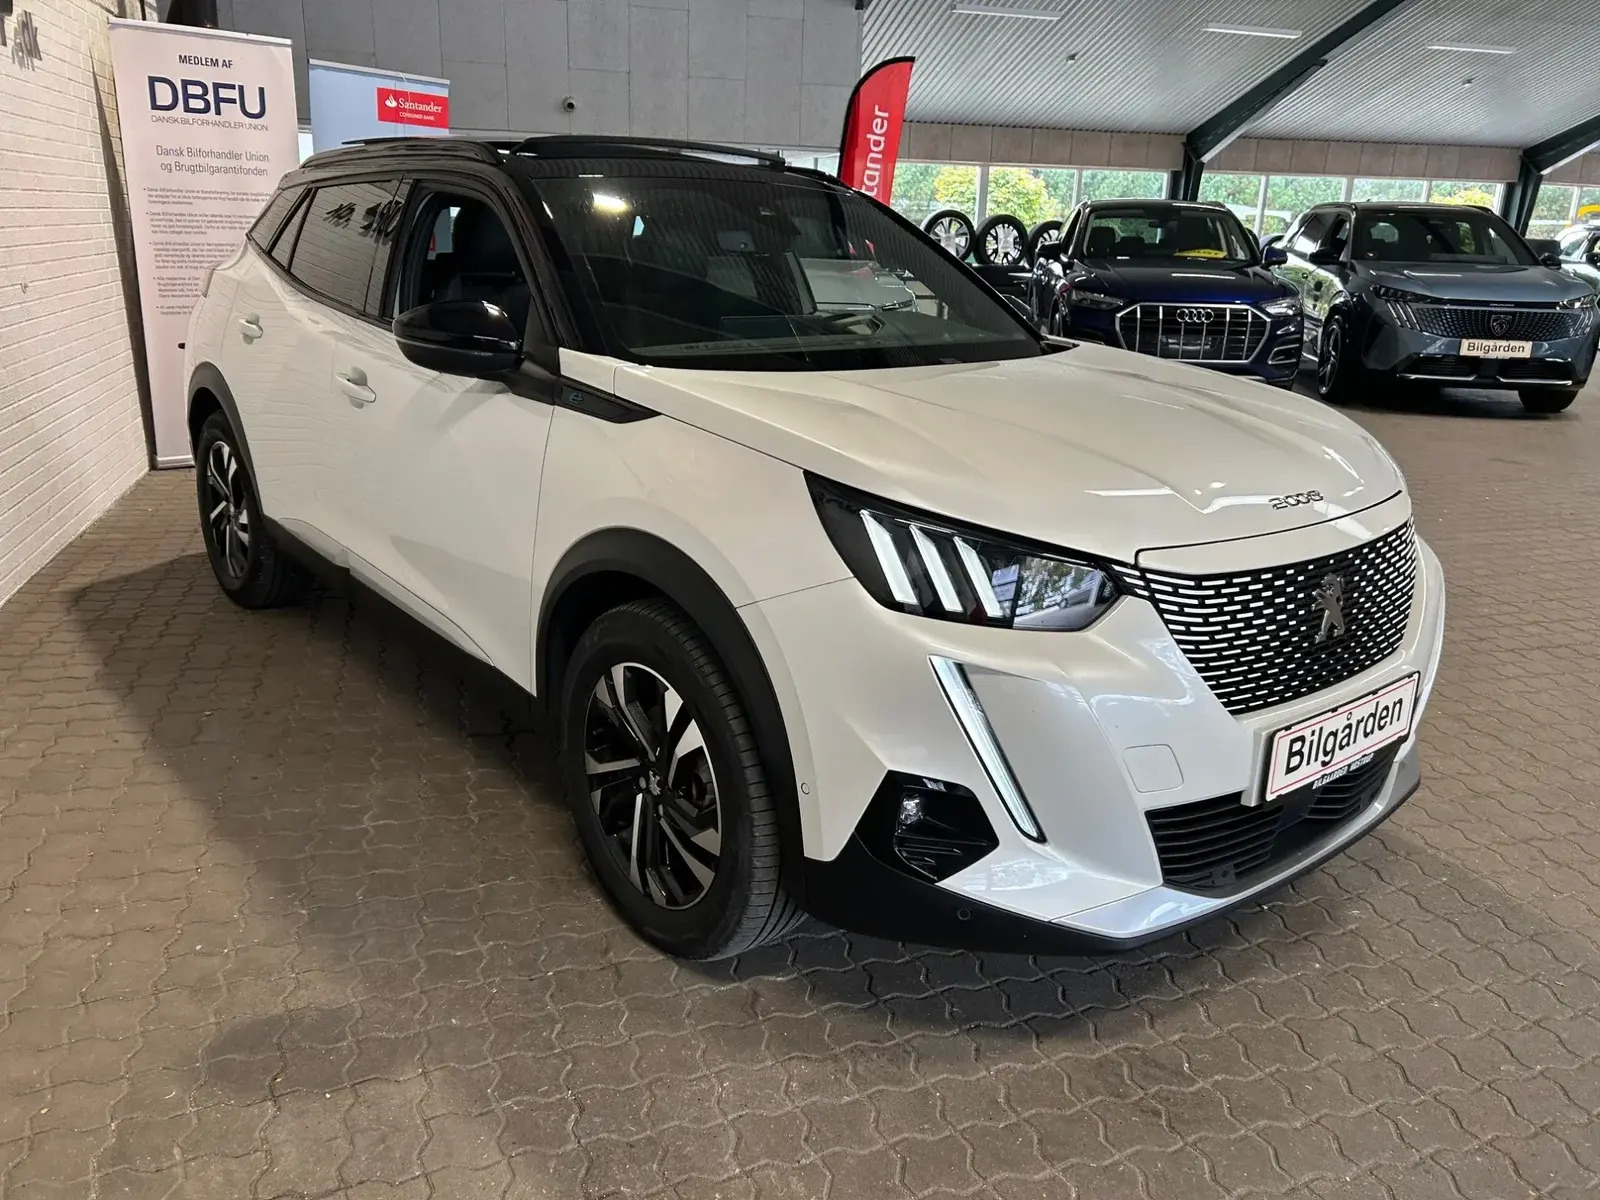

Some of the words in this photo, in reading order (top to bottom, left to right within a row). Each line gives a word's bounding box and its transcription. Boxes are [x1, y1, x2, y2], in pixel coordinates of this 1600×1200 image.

[178, 54, 220, 68] MEDLEM
[221, 58, 234, 69] AF
[147, 75, 267, 120] DBFU
[398, 97, 443, 114] Santander
[151, 114, 180, 125] DANSK
[180, 117, 244, 130] BILFORHANDLER
[245, 122, 268, 132] UNION
[399, 111, 423, 120] CONSUMER
[156, 145, 185, 158] Dansk
[187, 147, 244, 161] Bilforhandler
[245, 150, 270, 163] Union
[160, 162, 172, 174] og
[174, 161, 268, 177] Brugtbilgarantifonden
[1467, 341, 1525, 355] Bilgården
[1268, 489, 1324, 511] 2008
[1284, 696, 1404, 776] Bilgården
